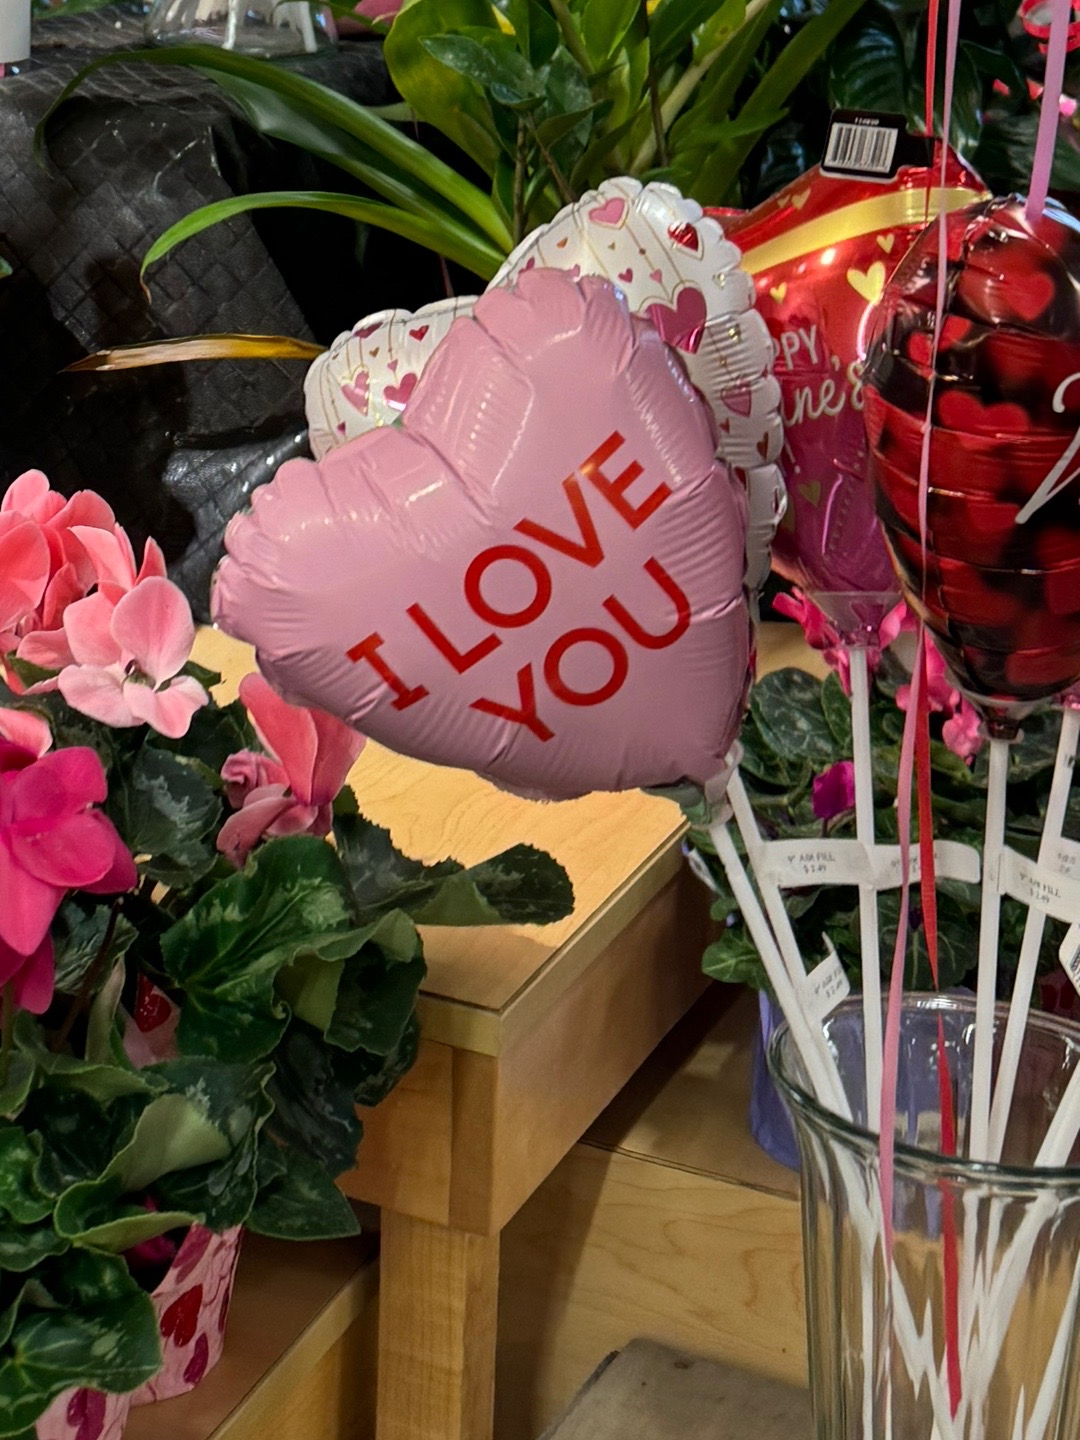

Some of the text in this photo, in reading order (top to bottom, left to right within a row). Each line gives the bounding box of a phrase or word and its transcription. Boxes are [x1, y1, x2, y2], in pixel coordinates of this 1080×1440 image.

[347, 430, 672, 712] I LOVE
[468, 555, 692, 744] YOU
